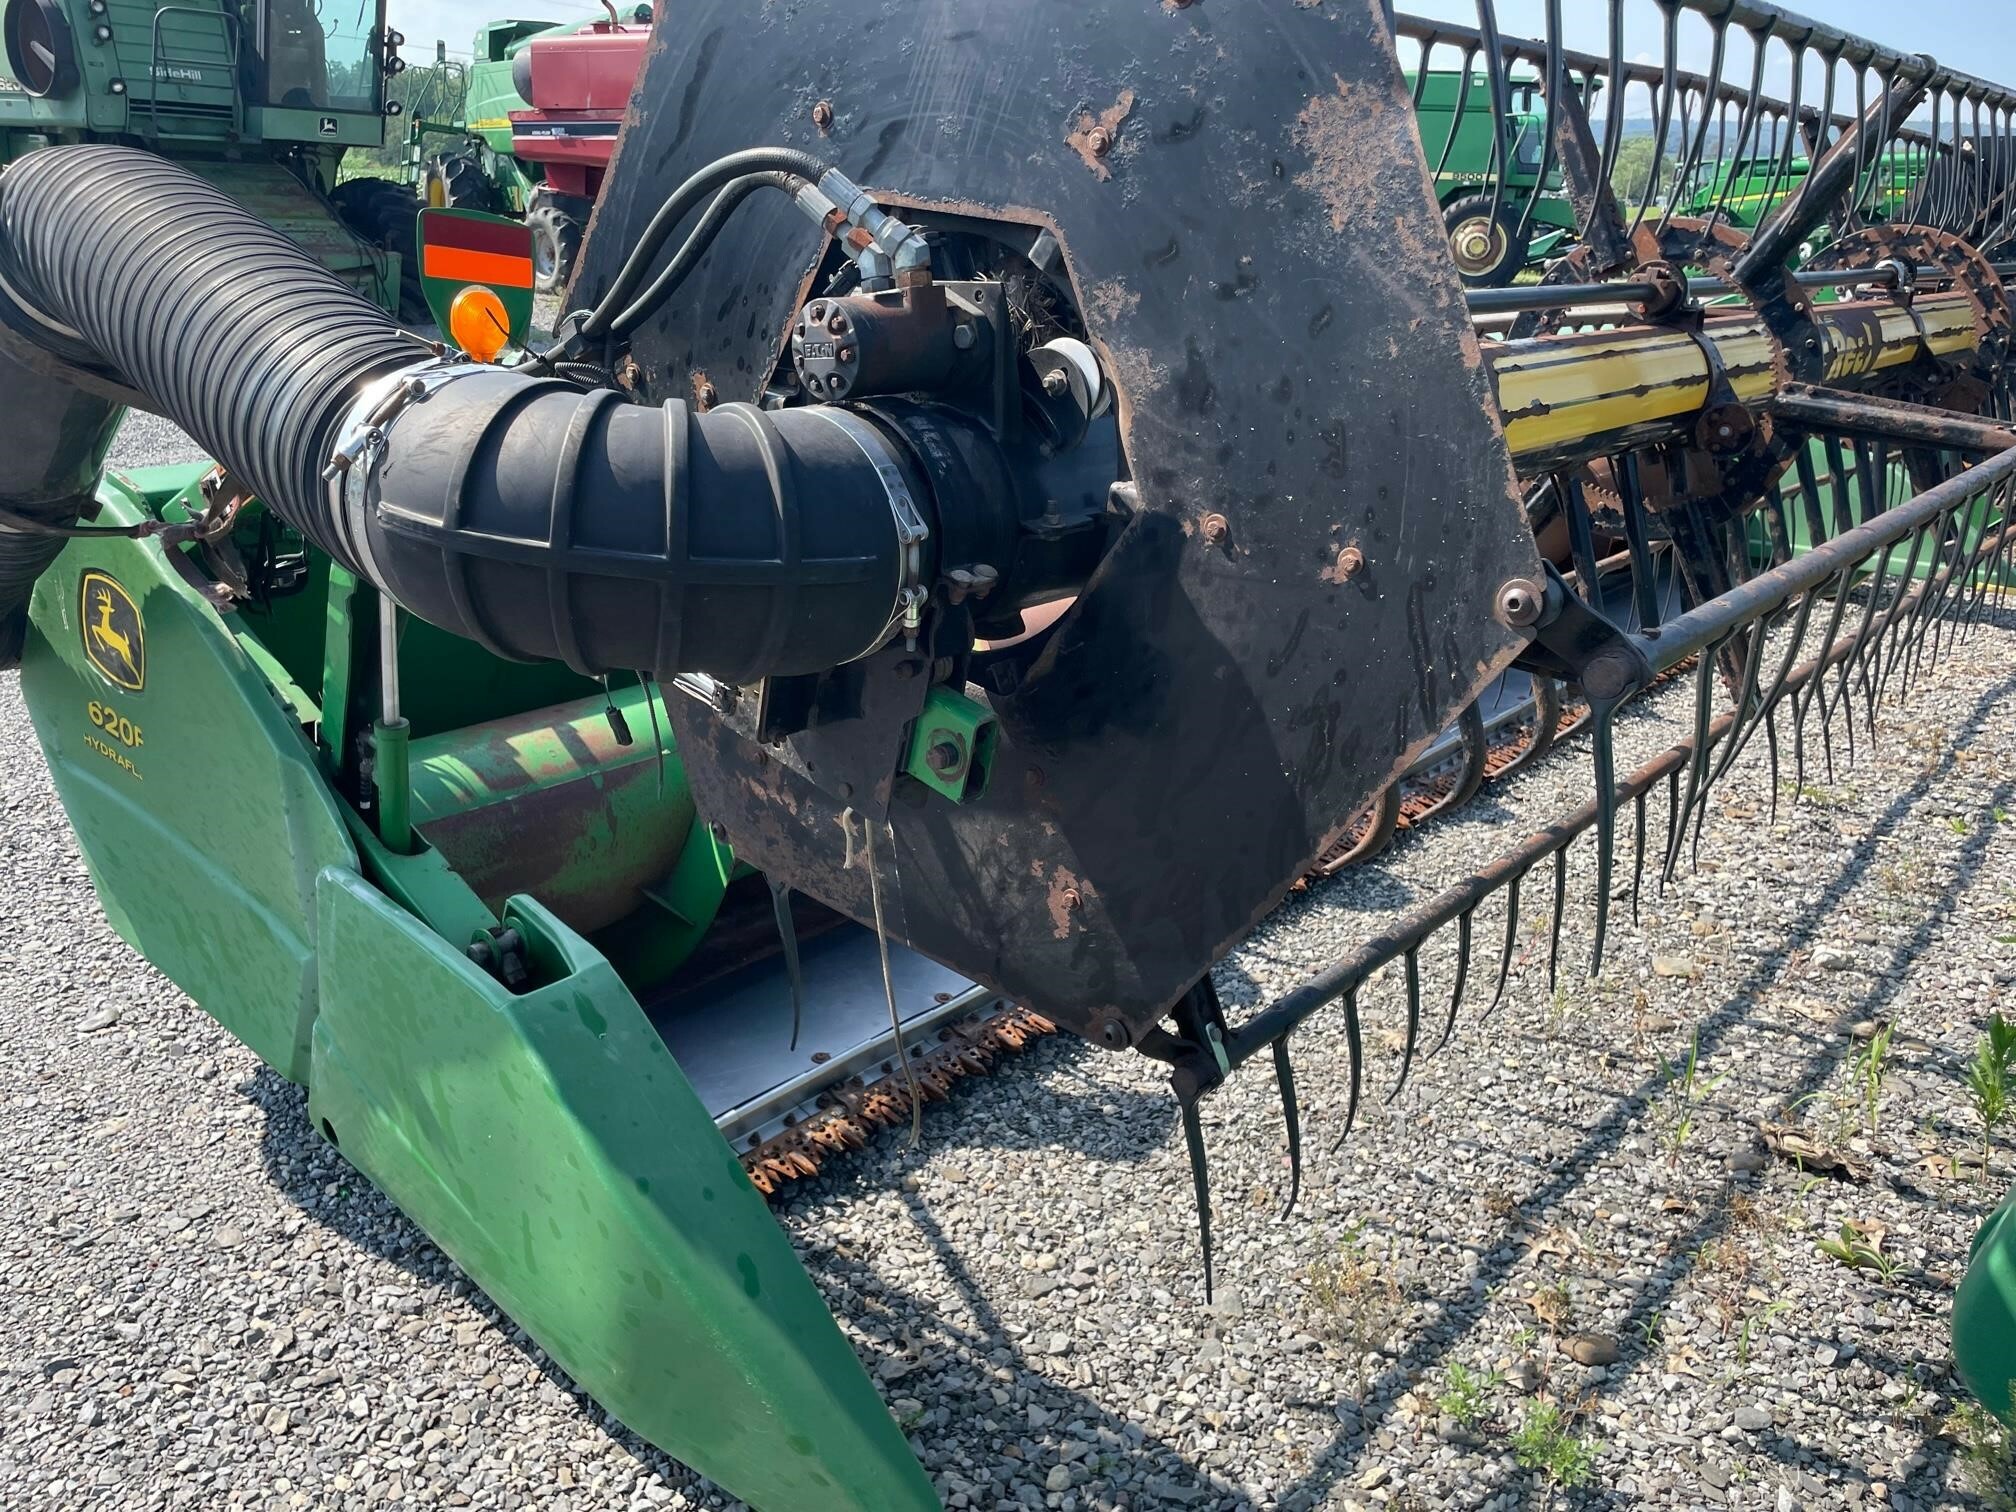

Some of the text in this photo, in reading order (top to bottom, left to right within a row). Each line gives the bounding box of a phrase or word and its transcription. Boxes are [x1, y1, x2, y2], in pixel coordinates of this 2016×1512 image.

[149, 66, 202, 80] SideHill
[88, 701, 144, 747] 620F
[83, 733, 143, 781] HYDRAFL
